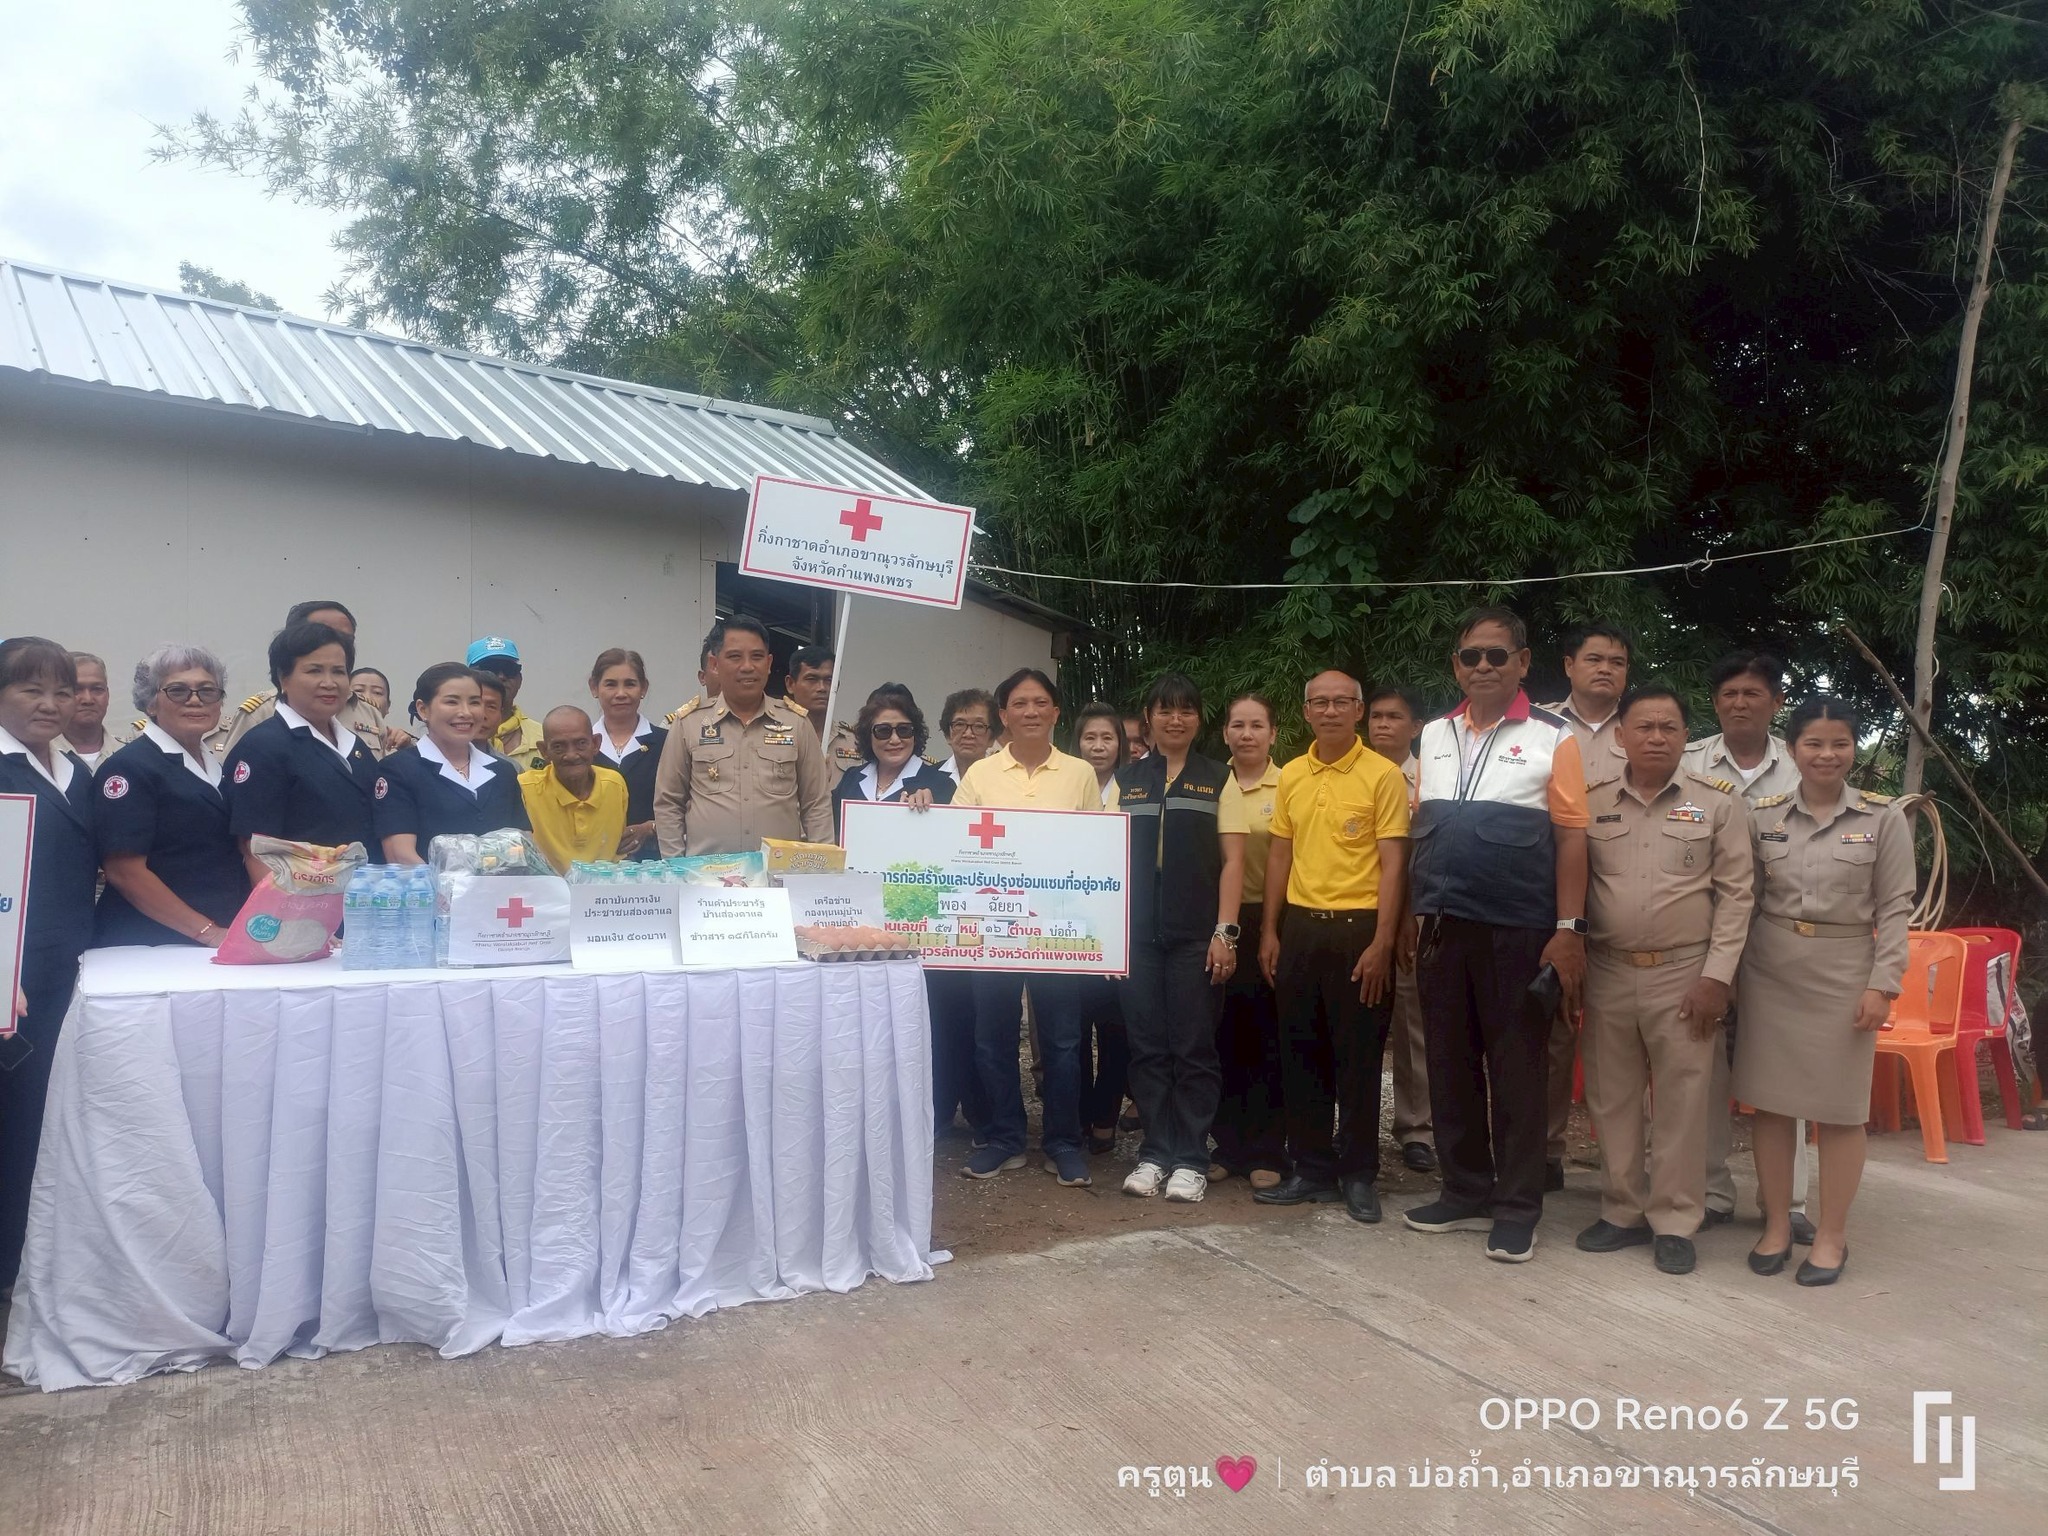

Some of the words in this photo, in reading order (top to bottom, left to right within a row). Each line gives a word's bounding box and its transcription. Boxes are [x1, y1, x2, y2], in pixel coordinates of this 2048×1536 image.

[757, 525, 954, 578] กิ่งกาชาดอำเภอขาณุวรลักษบุรี
[792, 556, 913, 589] จังหวัดกำแพงเพชร
[847, 866, 1121, 895] การก่อสร้างและปรับปรุงซ่อมแซมที่อยู่อาศัย
[594, 894, 661, 905] สถาบันการเงิน
[814, 896, 851, 906] เครือข่าย
[940, 899, 967, 912] พอง
[988, 895, 1023, 913] ฉัยยา
[804, 906, 863, 918] กองทุนหมู่บ้าน
[587, 932, 624, 943] มอบเงิน
[690, 932, 725, 941] ข้าวสาร
[960, 922, 978, 938] หมู่
[1009, 922, 1042, 937] ตำบล
[1049, 920, 1078, 938] บ่อถ้ำ
[988, 946, 1104, 963] จังหวัดกำแพงเพชร
